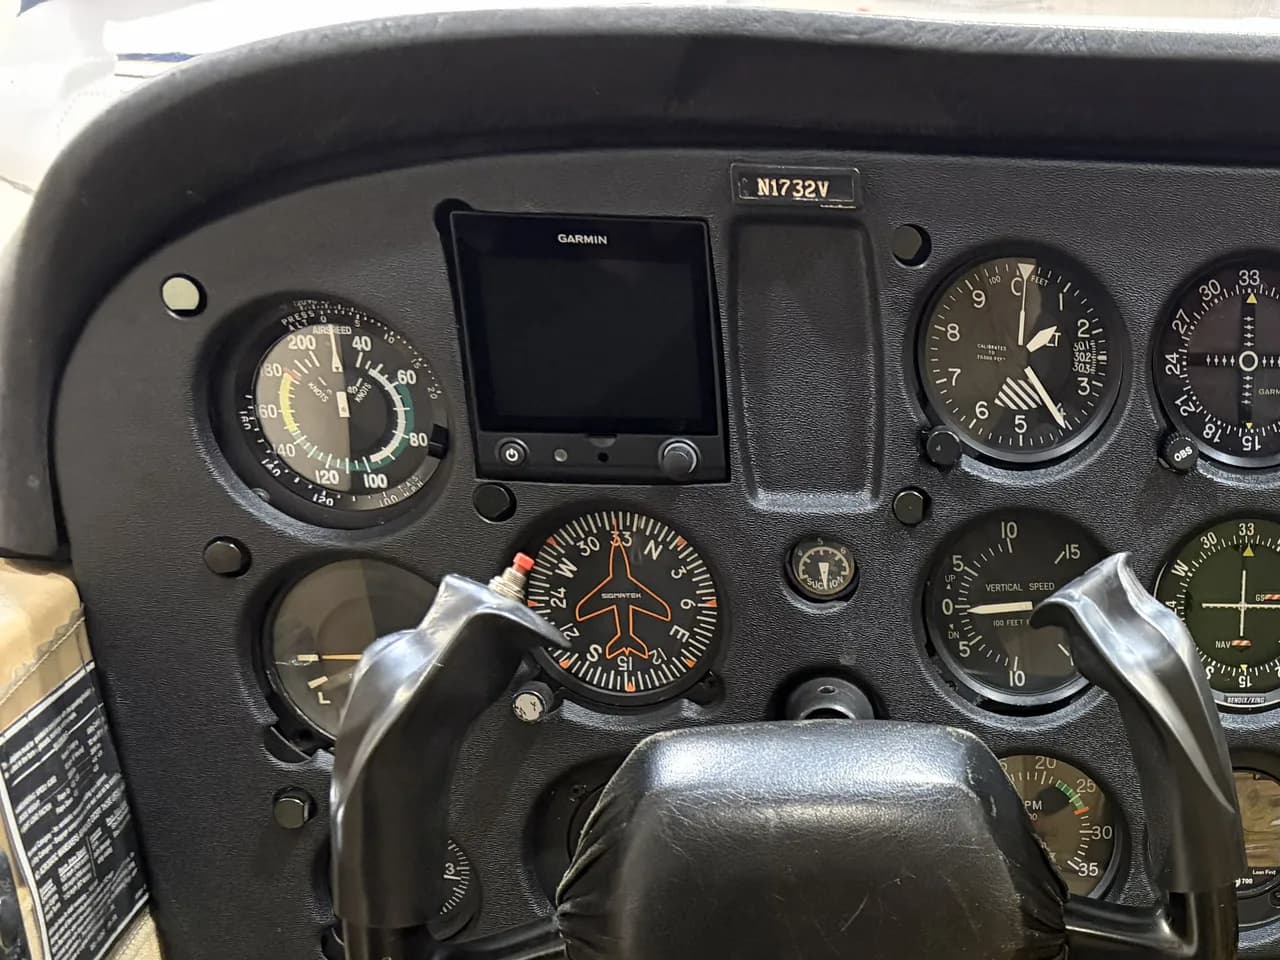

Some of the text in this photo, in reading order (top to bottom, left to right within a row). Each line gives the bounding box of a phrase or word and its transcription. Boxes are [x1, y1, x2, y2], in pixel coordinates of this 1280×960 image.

[757, 178, 829, 197] N1732V
[558, 234, 607, 245] GARMIN
[1031, 275, 1049, 286] FEET
[1239, 270, 1260, 285] 33
[1199, 279, 1221, 300] 30
[972, 290, 986, 309] 9
[1077, 319, 1090, 337] 2
[1172, 309, 1190, 334] 27
[947, 323, 960, 341] 8
[288, 335, 315, 350] 200
[352, 337, 371, 351] 40
[1165, 352, 1180, 375] 24
[397, 370, 416, 384] 60
[948, 368, 961, 386] 7
[1078, 378, 1089, 395] 3
[975, 401, 989, 419] 6
[1014, 416, 1027, 433] 5
[409, 433, 427, 446] 80
[1174, 446, 1193, 462] OBS
[316, 471, 339, 484] 120
[364, 474, 387, 488] 100
[1001, 522, 1017, 538] 10
[1239, 523, 1254, 535] 33
[576, 536, 600, 556] 30
[1201, 532, 1217, 549] 30
[644, 540, 663, 560] N
[1065, 544, 1080, 559] 15
[555, 558, 577, 578] W
[1171, 560, 1189, 577] W
[986, 583, 1055, 592] VERTICAL SPEED
[1009, 671, 1025, 686] 10
[1227, 696, 1265, 704] BENDIX/KING
[1035, 756, 1056, 769] 20
[1076, 780, 1096, 793] 25
[1092, 826, 1112, 839] 30
[1079, 864, 1098, 876] 35
